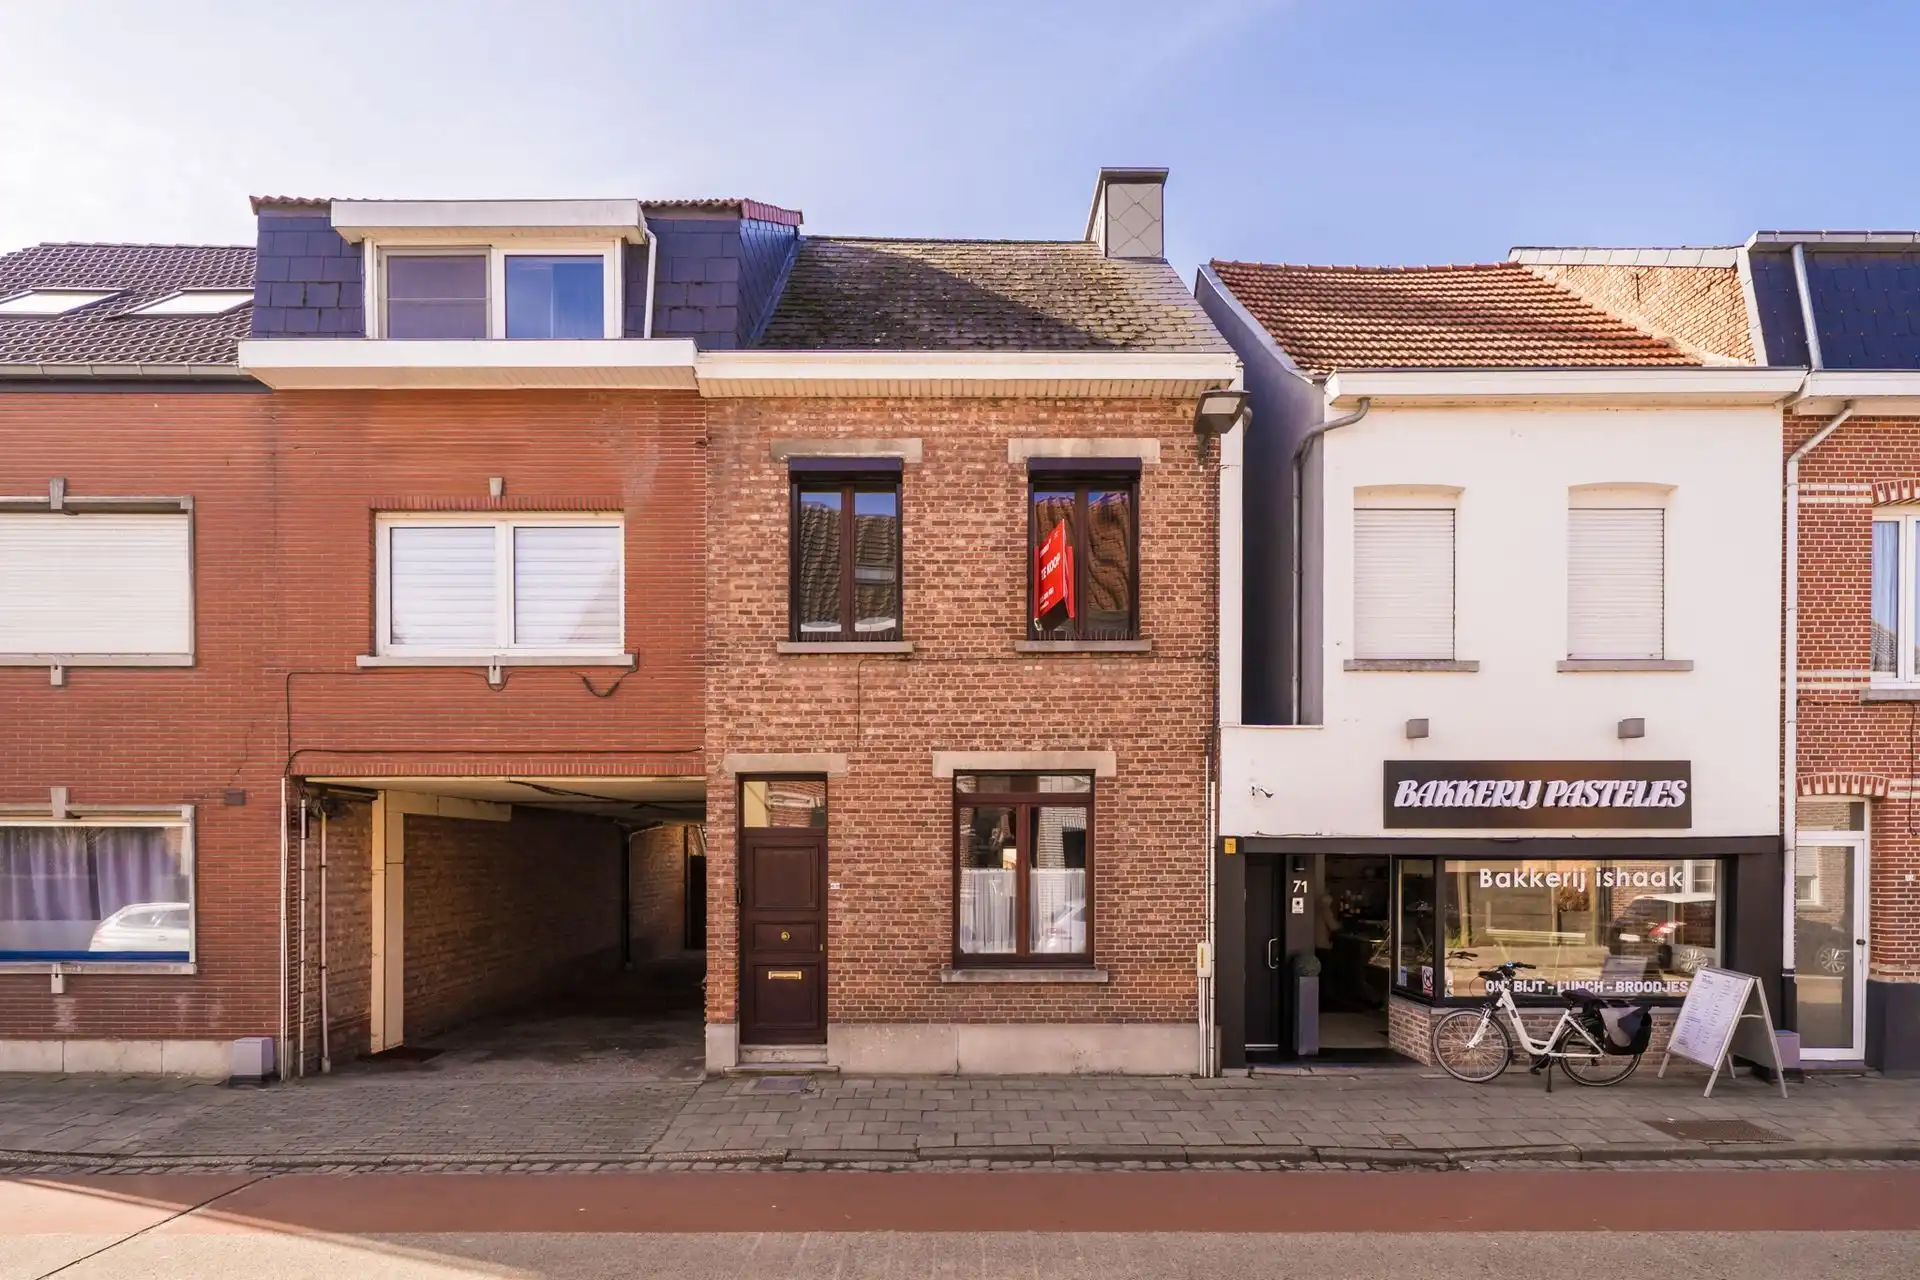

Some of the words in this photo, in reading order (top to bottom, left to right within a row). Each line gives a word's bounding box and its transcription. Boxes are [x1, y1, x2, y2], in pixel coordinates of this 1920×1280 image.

[1047, 552, 1061, 576] KOOP
[1394, 779, 1542, 810] BAKKERIJ
[1542, 779, 1688, 808] PASTELES
[1293, 879, 1308, 893] 71
[1479, 868, 1586, 892] Bakkerij
[1596, 867, 1684, 888] ishaak
[1615, 980, 1689, 993] BROODJES
